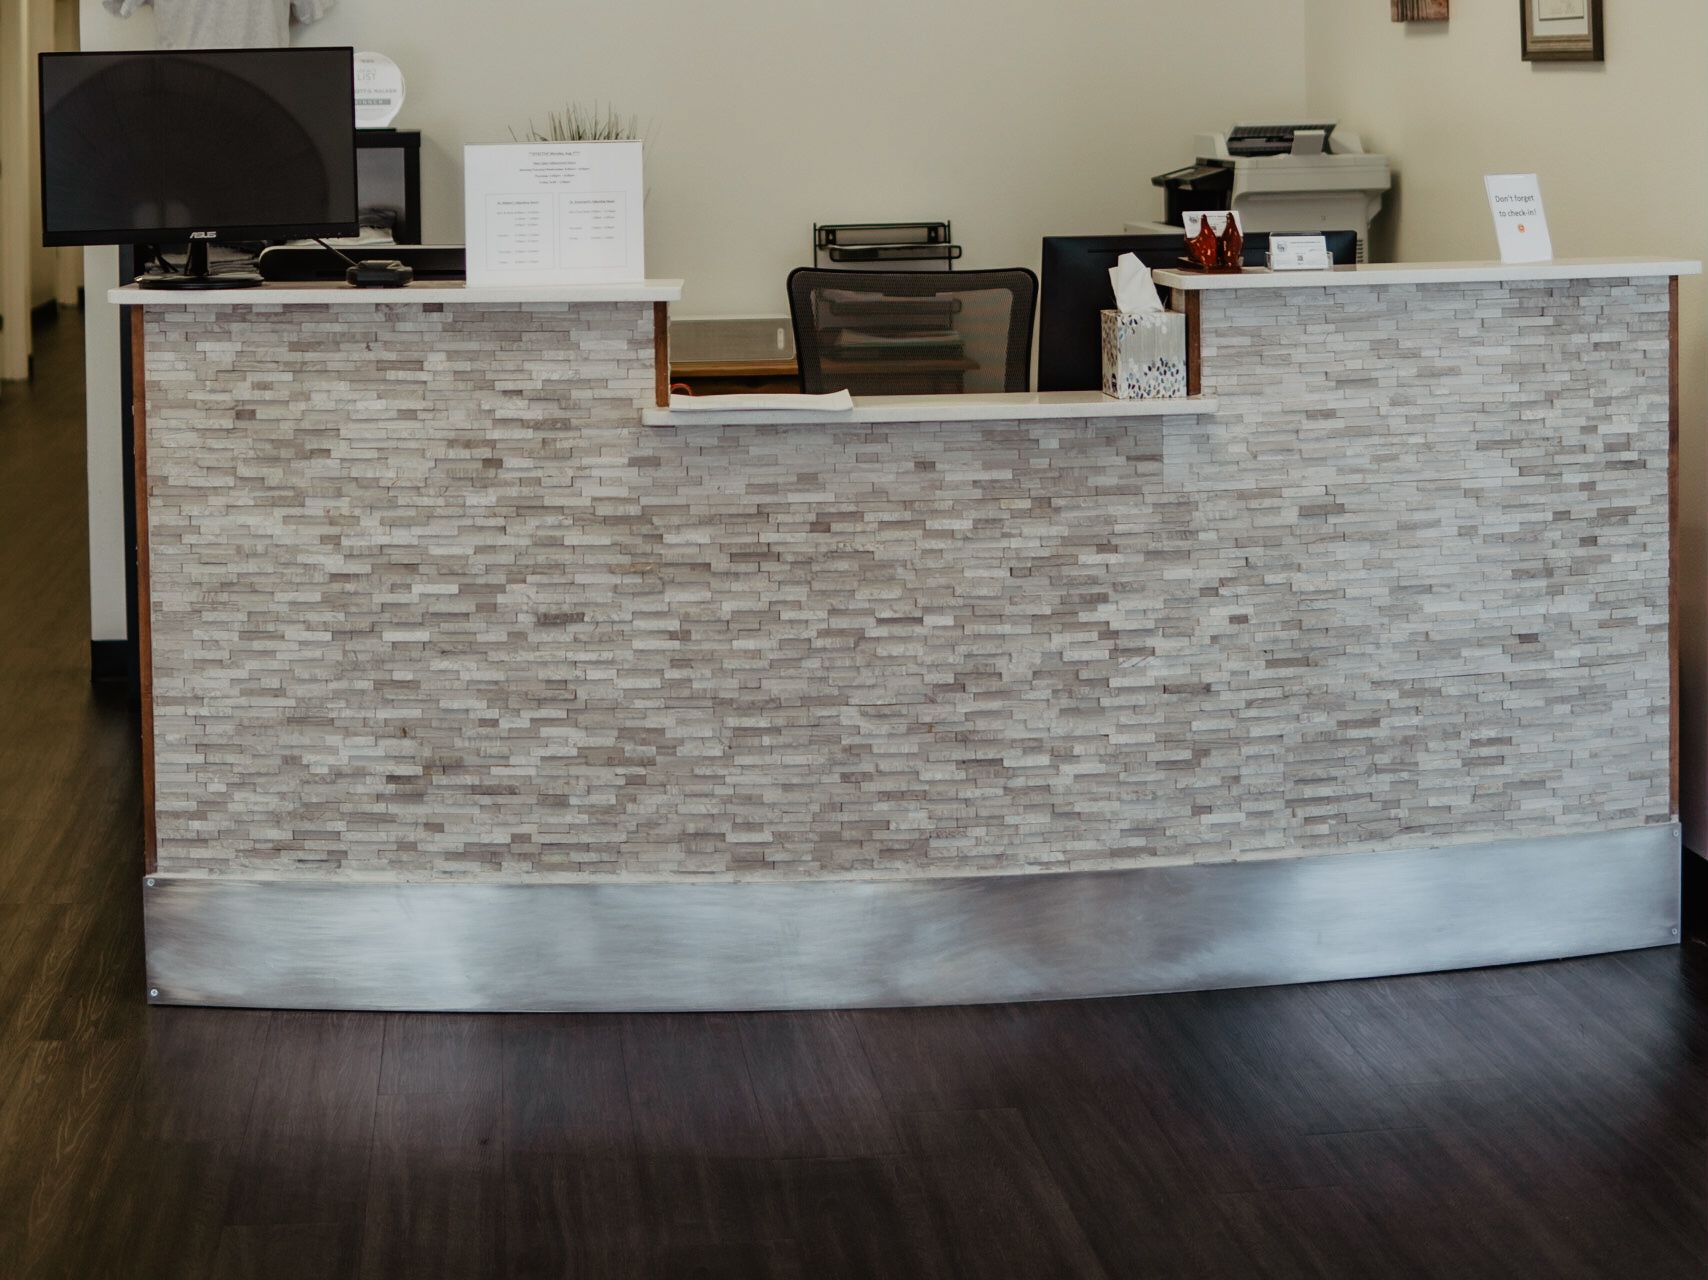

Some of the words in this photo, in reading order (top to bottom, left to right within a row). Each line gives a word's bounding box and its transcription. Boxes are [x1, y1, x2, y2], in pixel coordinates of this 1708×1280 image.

[1495, 194, 1513, 203] Don't
[1514, 194, 1535, 203] forget
[1508, 208, 1537, 217] check-in!
[189, 231, 217, 239] ASUS
